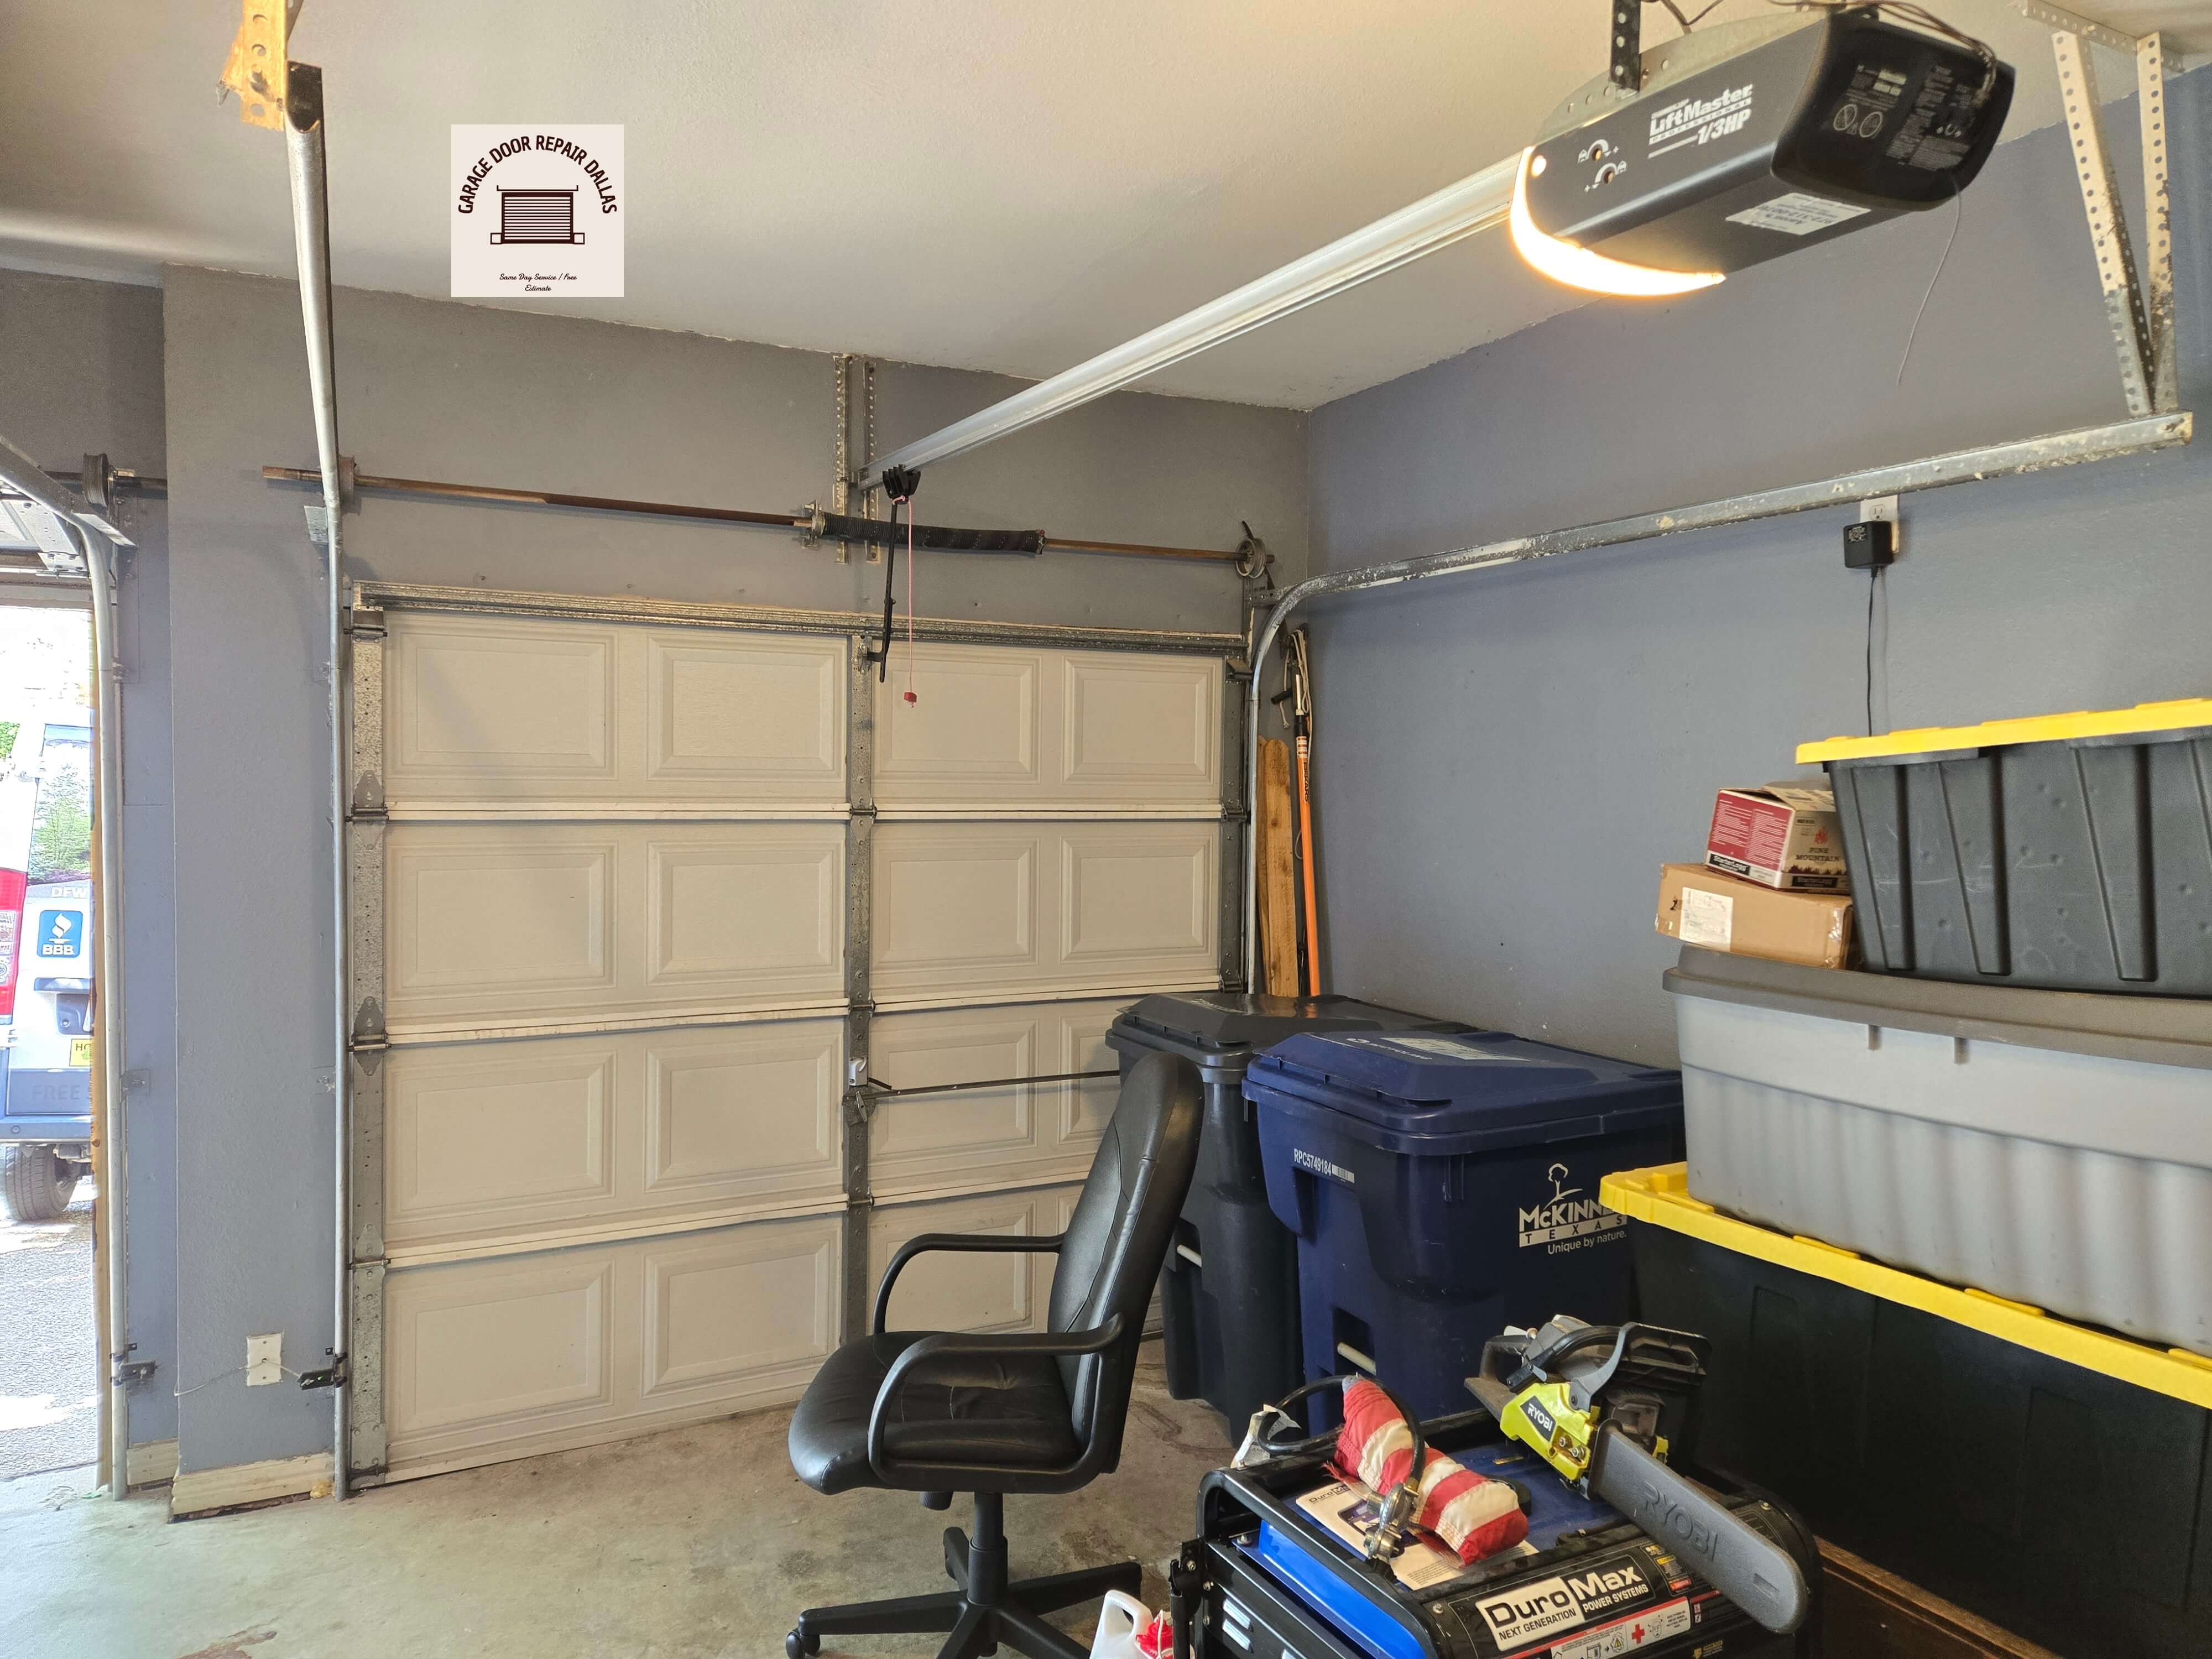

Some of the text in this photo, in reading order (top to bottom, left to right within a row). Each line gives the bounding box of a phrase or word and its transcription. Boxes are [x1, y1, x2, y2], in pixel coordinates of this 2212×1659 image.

[1650, 84, 1752, 137] LiftMaster
[1651, 100, 1750, 142] PROFESSIONAL
[1698, 108, 1751, 145] 1/3HP
[42, 943, 75, 956] BBB
[1293, 1147, 1332, 1176] RPC5749184
[1525, 1216, 1623, 1244] TEXAS
[1548, 1229, 1627, 1255] Unique by nature.
[1528, 1402, 1553, 1432] RYOBI
[1643, 1481, 1718, 1562] RYOBI
[1583, 1595, 1613, 1613] POWER
[1614, 1584, 1649, 1603] SYSTEMS
[1498, 1608, 1577, 1641] NEXT GENERATION
